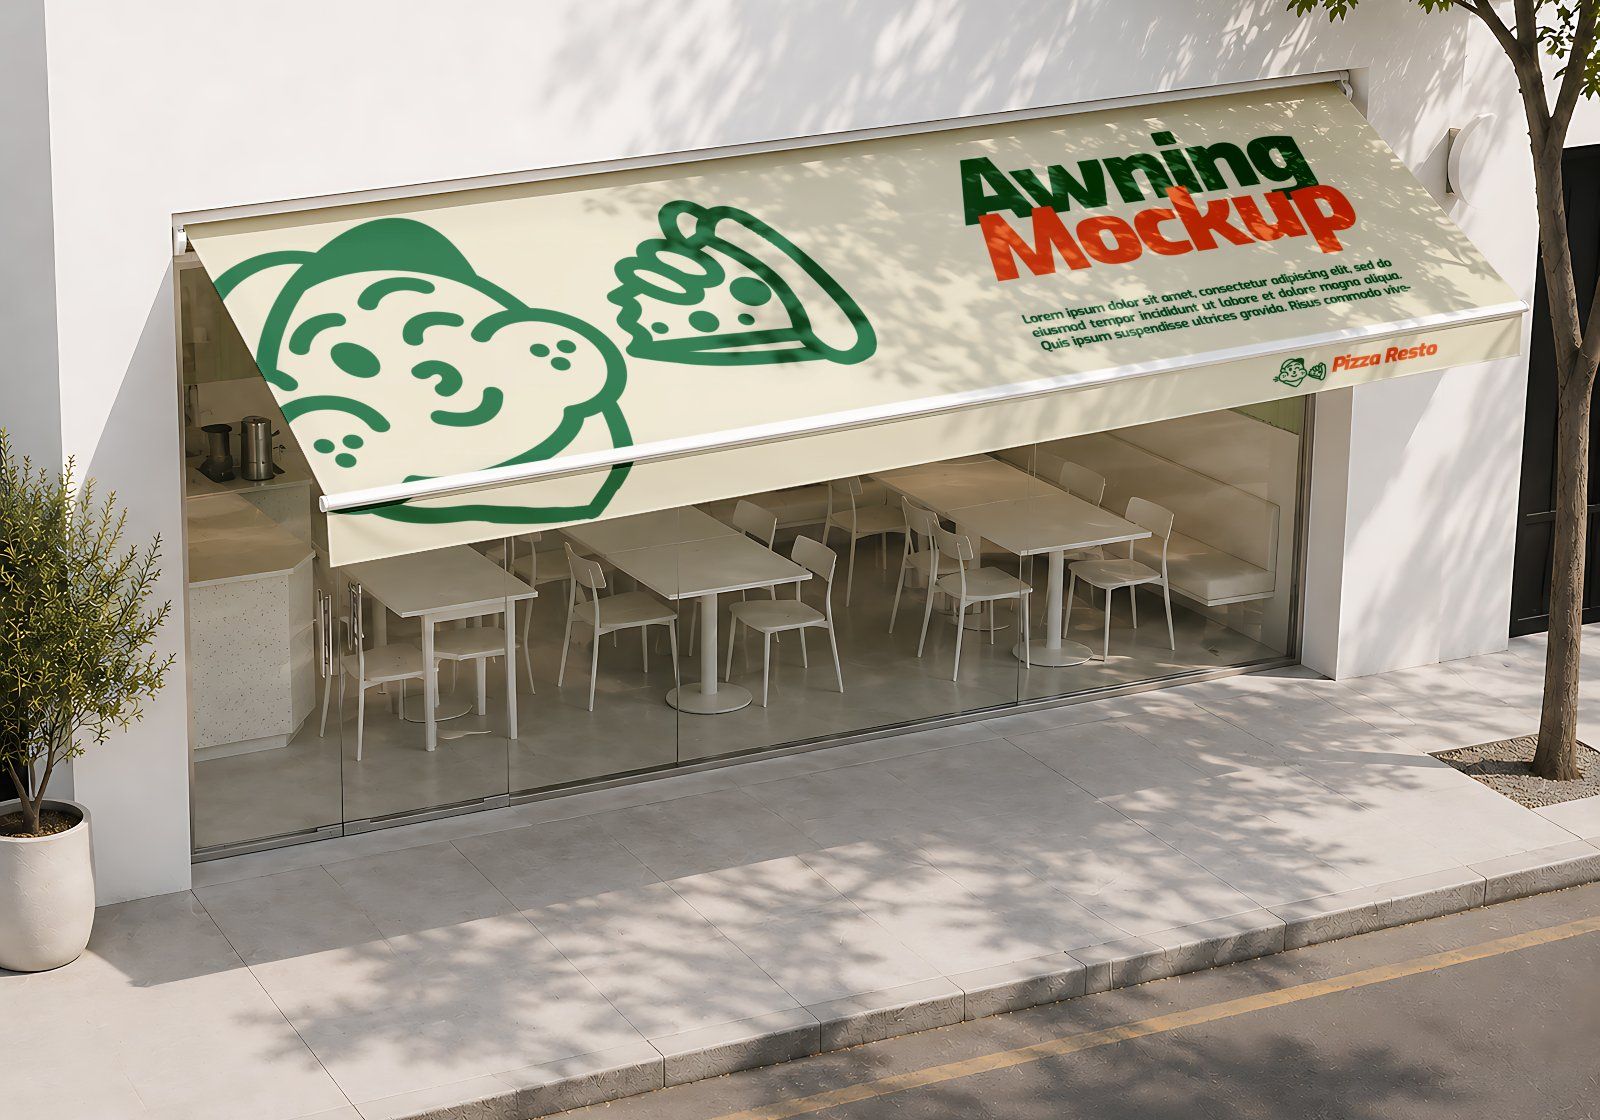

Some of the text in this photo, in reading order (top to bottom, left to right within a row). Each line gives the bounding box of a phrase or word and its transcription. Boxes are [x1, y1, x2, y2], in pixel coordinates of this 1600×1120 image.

[959, 131, 1319, 225] Awning
[978, 185, 1357, 282] Mockup
[1021, 258, 1393, 325] Lorem ipsum dolor sit amet, consectetur adipiscing elit, sed do
[1032, 271, 1403, 338] eiusmod tempor incididunt ut labore et dolore magna aliqua.
[1040, 283, 1412, 353] Quis ipsum suspendisse ultrices gravida. Risus commodo vive-
[1331, 343, 1438, 373] Pizza Resto
